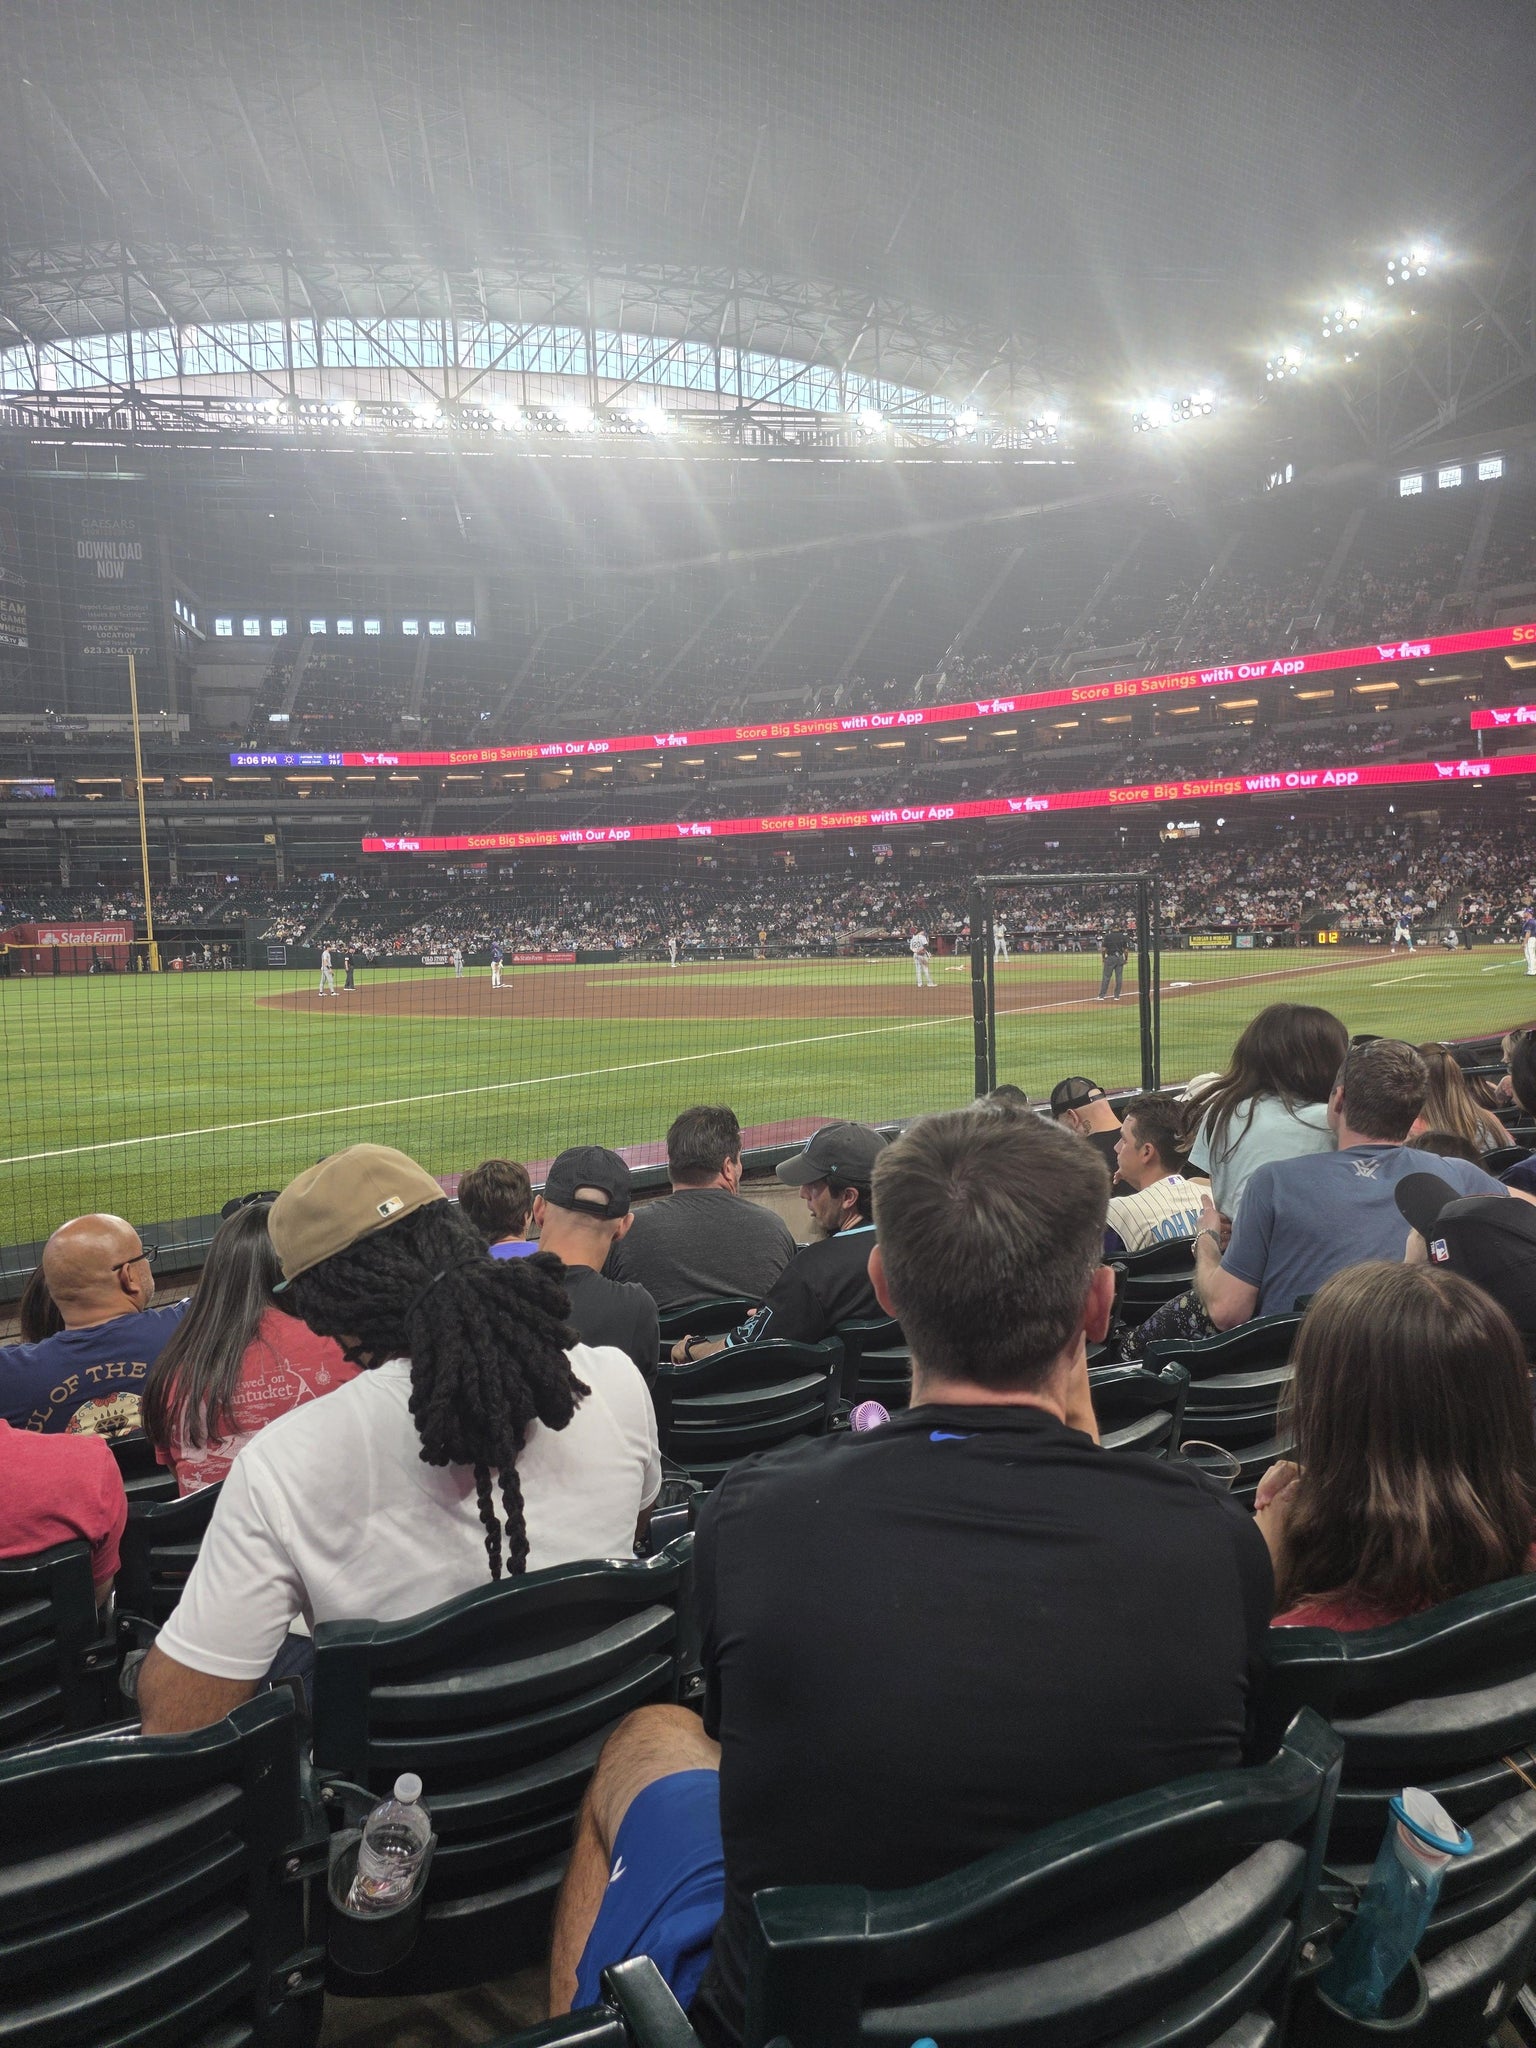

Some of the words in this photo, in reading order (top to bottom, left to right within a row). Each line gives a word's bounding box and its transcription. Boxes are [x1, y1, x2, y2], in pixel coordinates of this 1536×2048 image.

[81, 518, 136, 529] CAESARS
[77, 540, 143, 560] DOWNLOAD
[96, 560, 125, 579] NOW
[1512, 627, 1536, 641] Sc
[83, 646, 151, 655] 623.304.0777
[1071, 687, 1109, 701] Score
[1113, 683, 1137, 696] Big
[1140, 675, 1197, 691] Savings
[1200, 668, 1234, 684] with
[1237, 664, 1266, 679] Our
[1271, 658, 1305, 676] App
[735, 728, 768, 739] Score
[771, 725, 790, 737] Big
[793, 720, 839, 734] Savings
[841, 716, 868, 729] with
[871, 715, 894, 727] Our
[897, 712, 923, 724] App
[237, 756, 259, 765] 2:06
[260, 756, 277, 765] PM
[449, 753, 478, 763] Score
[480, 750, 498, 762] Big
[500, 746, 538, 759] Savings
[540, 744, 562, 755] with
[565, 743, 584, 754] Our
[587, 741, 609, 753] App
[1108, 789, 1149, 802] Score
[1153, 784, 1178, 799] Big
[1182, 780, 1242, 795] Savings
[1246, 774, 1281, 791] with
[1285, 770, 1318, 787] Our
[1322, 769, 1359, 786] App
[761, 818, 794, 830] Score
[797, 816, 817, 829] Big
[820, 813, 868, 826] Savings
[870, 811, 898, 823] with
[901, 809, 925, 821] Our
[928, 807, 954, 819] App
[467, 837, 497, 847] Score
[498, 834, 516, 846] Big
[518, 832, 558, 844] Savings
[559, 831, 583, 842] with
[585, 829, 606, 841] Our
[608, 828, 631, 841] App
[60, 931, 93, 944] State
[93, 931, 123, 943] Farm
[1151, 1208, 1205, 1242] JOHN
[50, 1374, 80, 1404] OF
[85, 1361, 148, 1384] THE
[270, 1374, 286, 1385] on
